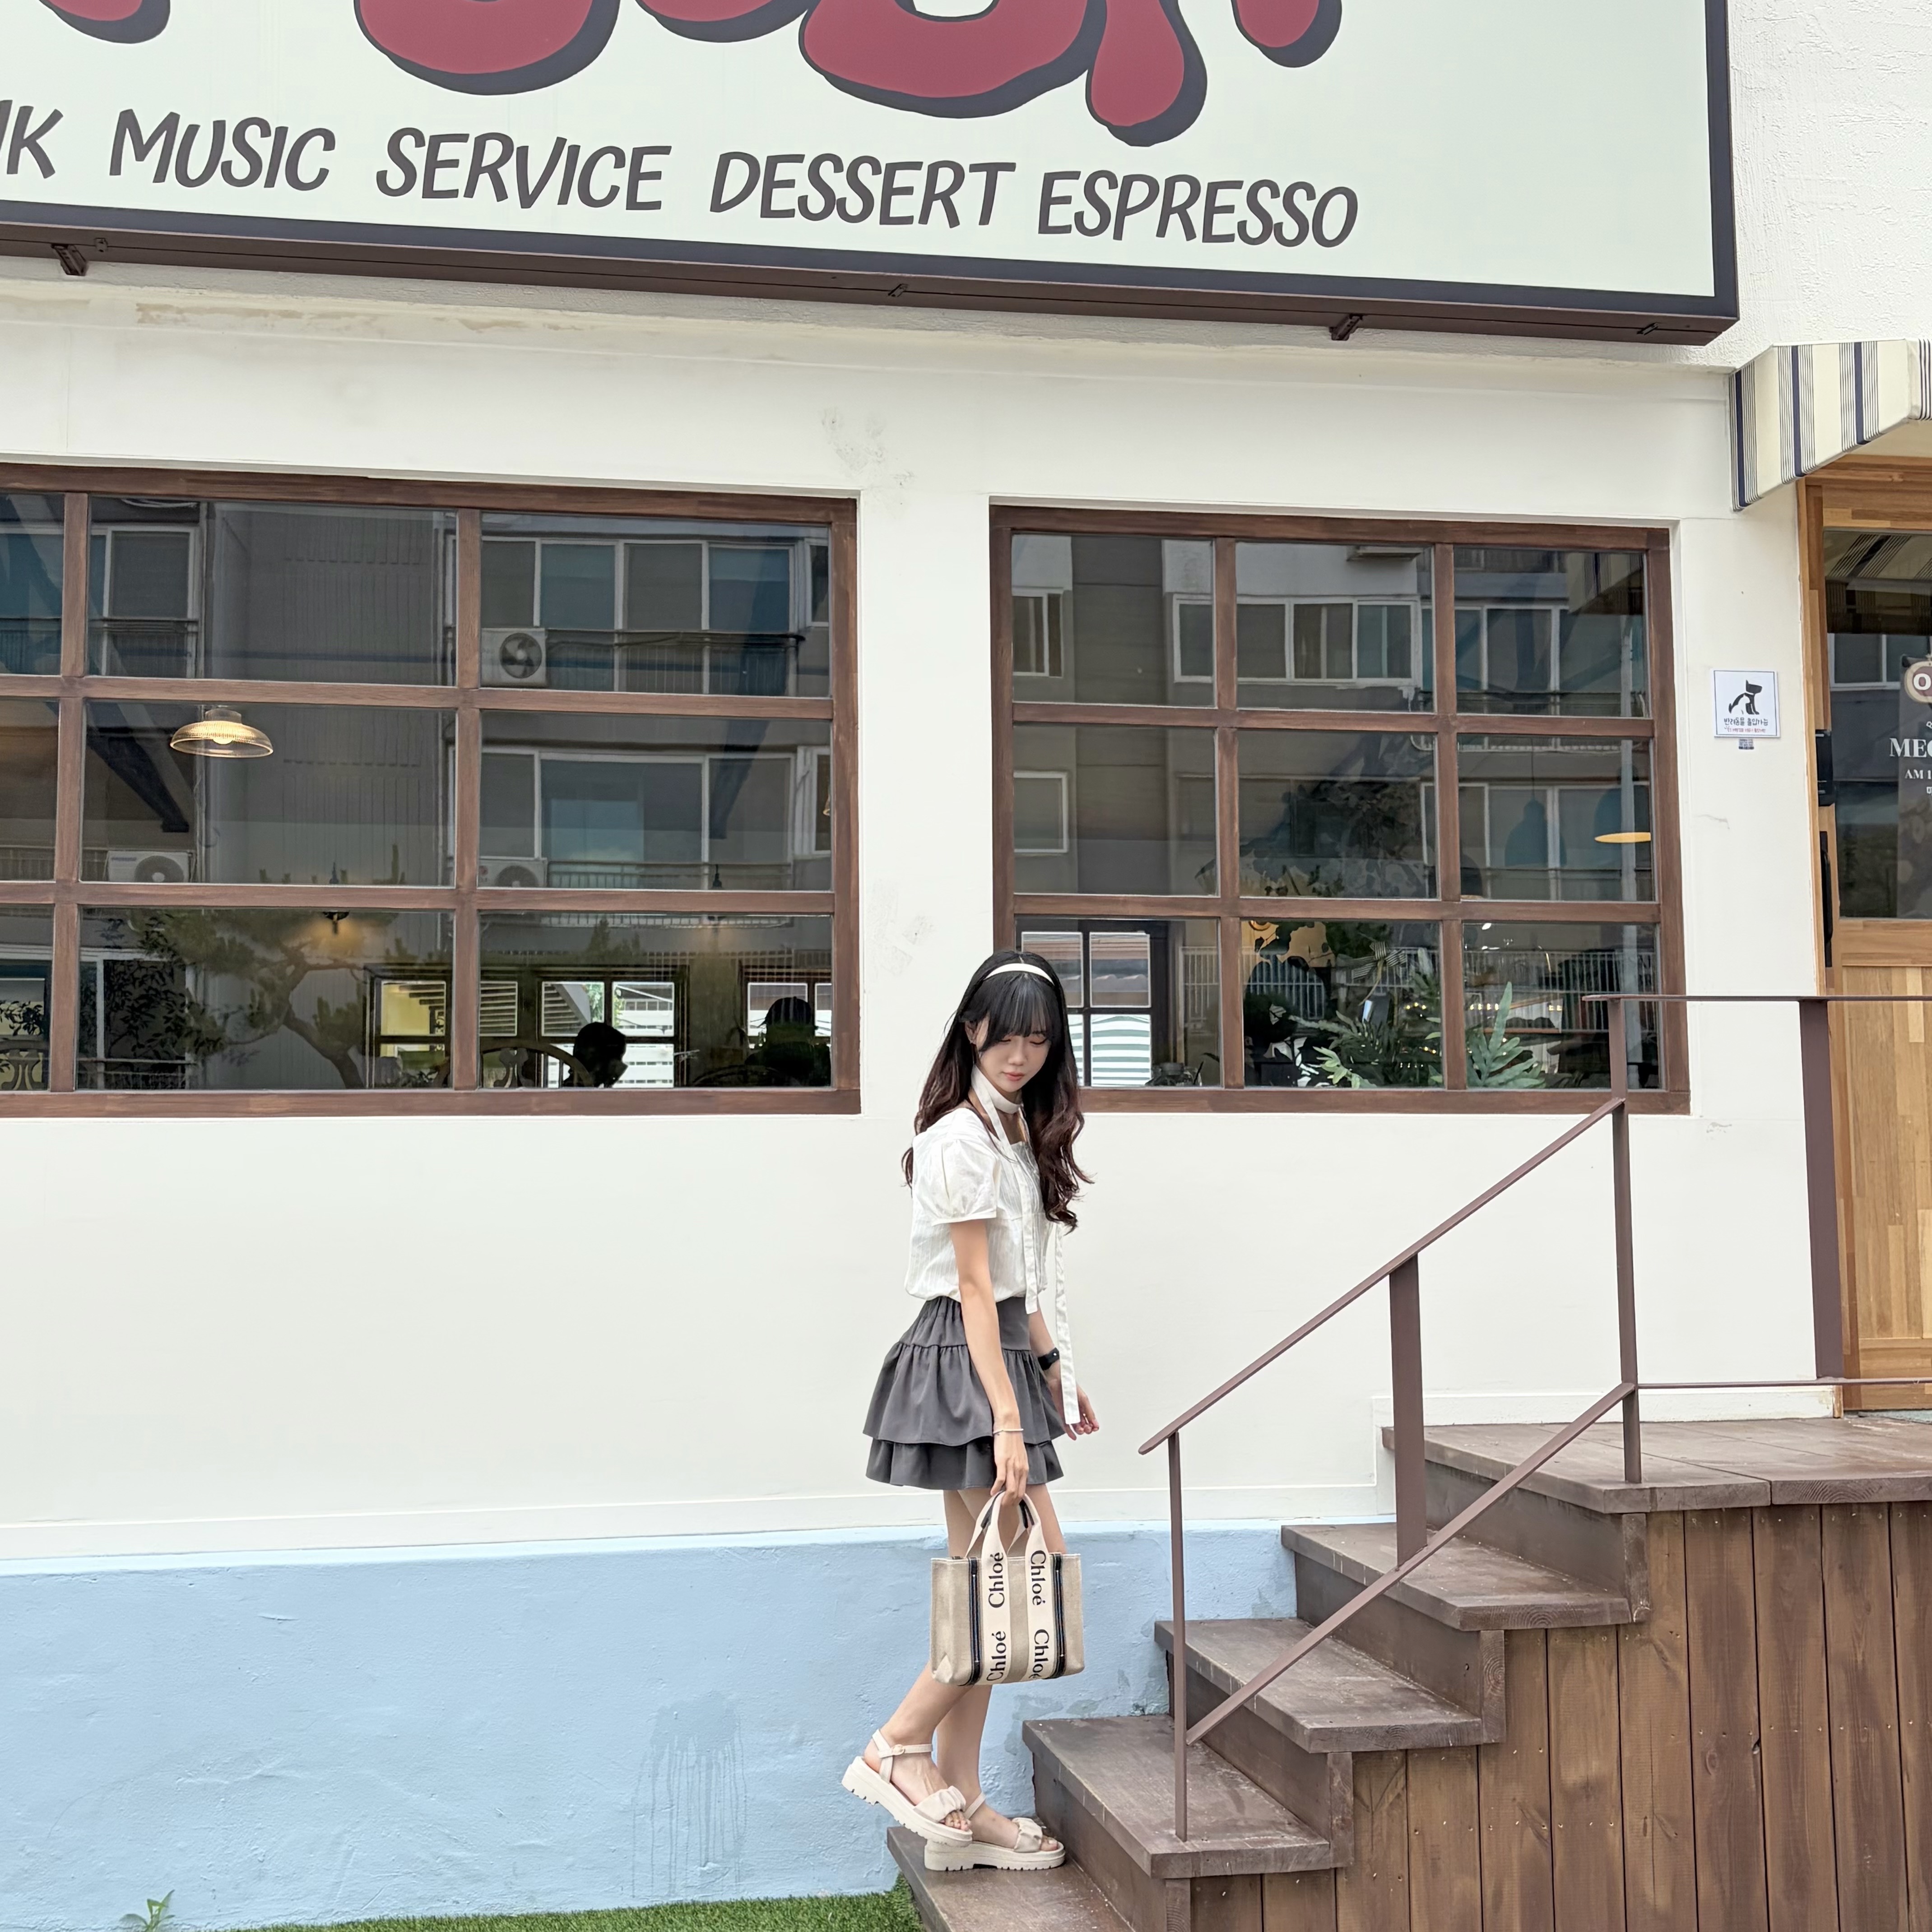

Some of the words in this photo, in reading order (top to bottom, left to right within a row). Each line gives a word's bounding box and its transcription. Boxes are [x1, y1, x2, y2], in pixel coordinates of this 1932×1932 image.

[109, 109, 336, 191] MUSIC
[376, 127, 672, 211] SERVICE
[710, 151, 1017, 229] DESSERT
[1038, 170, 1358, 248] ESPRESSO
[1904, 769, 1923, 779] AM
[988, 1552, 1005, 1608] Chloé
[1030, 1550, 1046, 1606] Chloé
[986, 1631, 1006, 1682] Chloé
